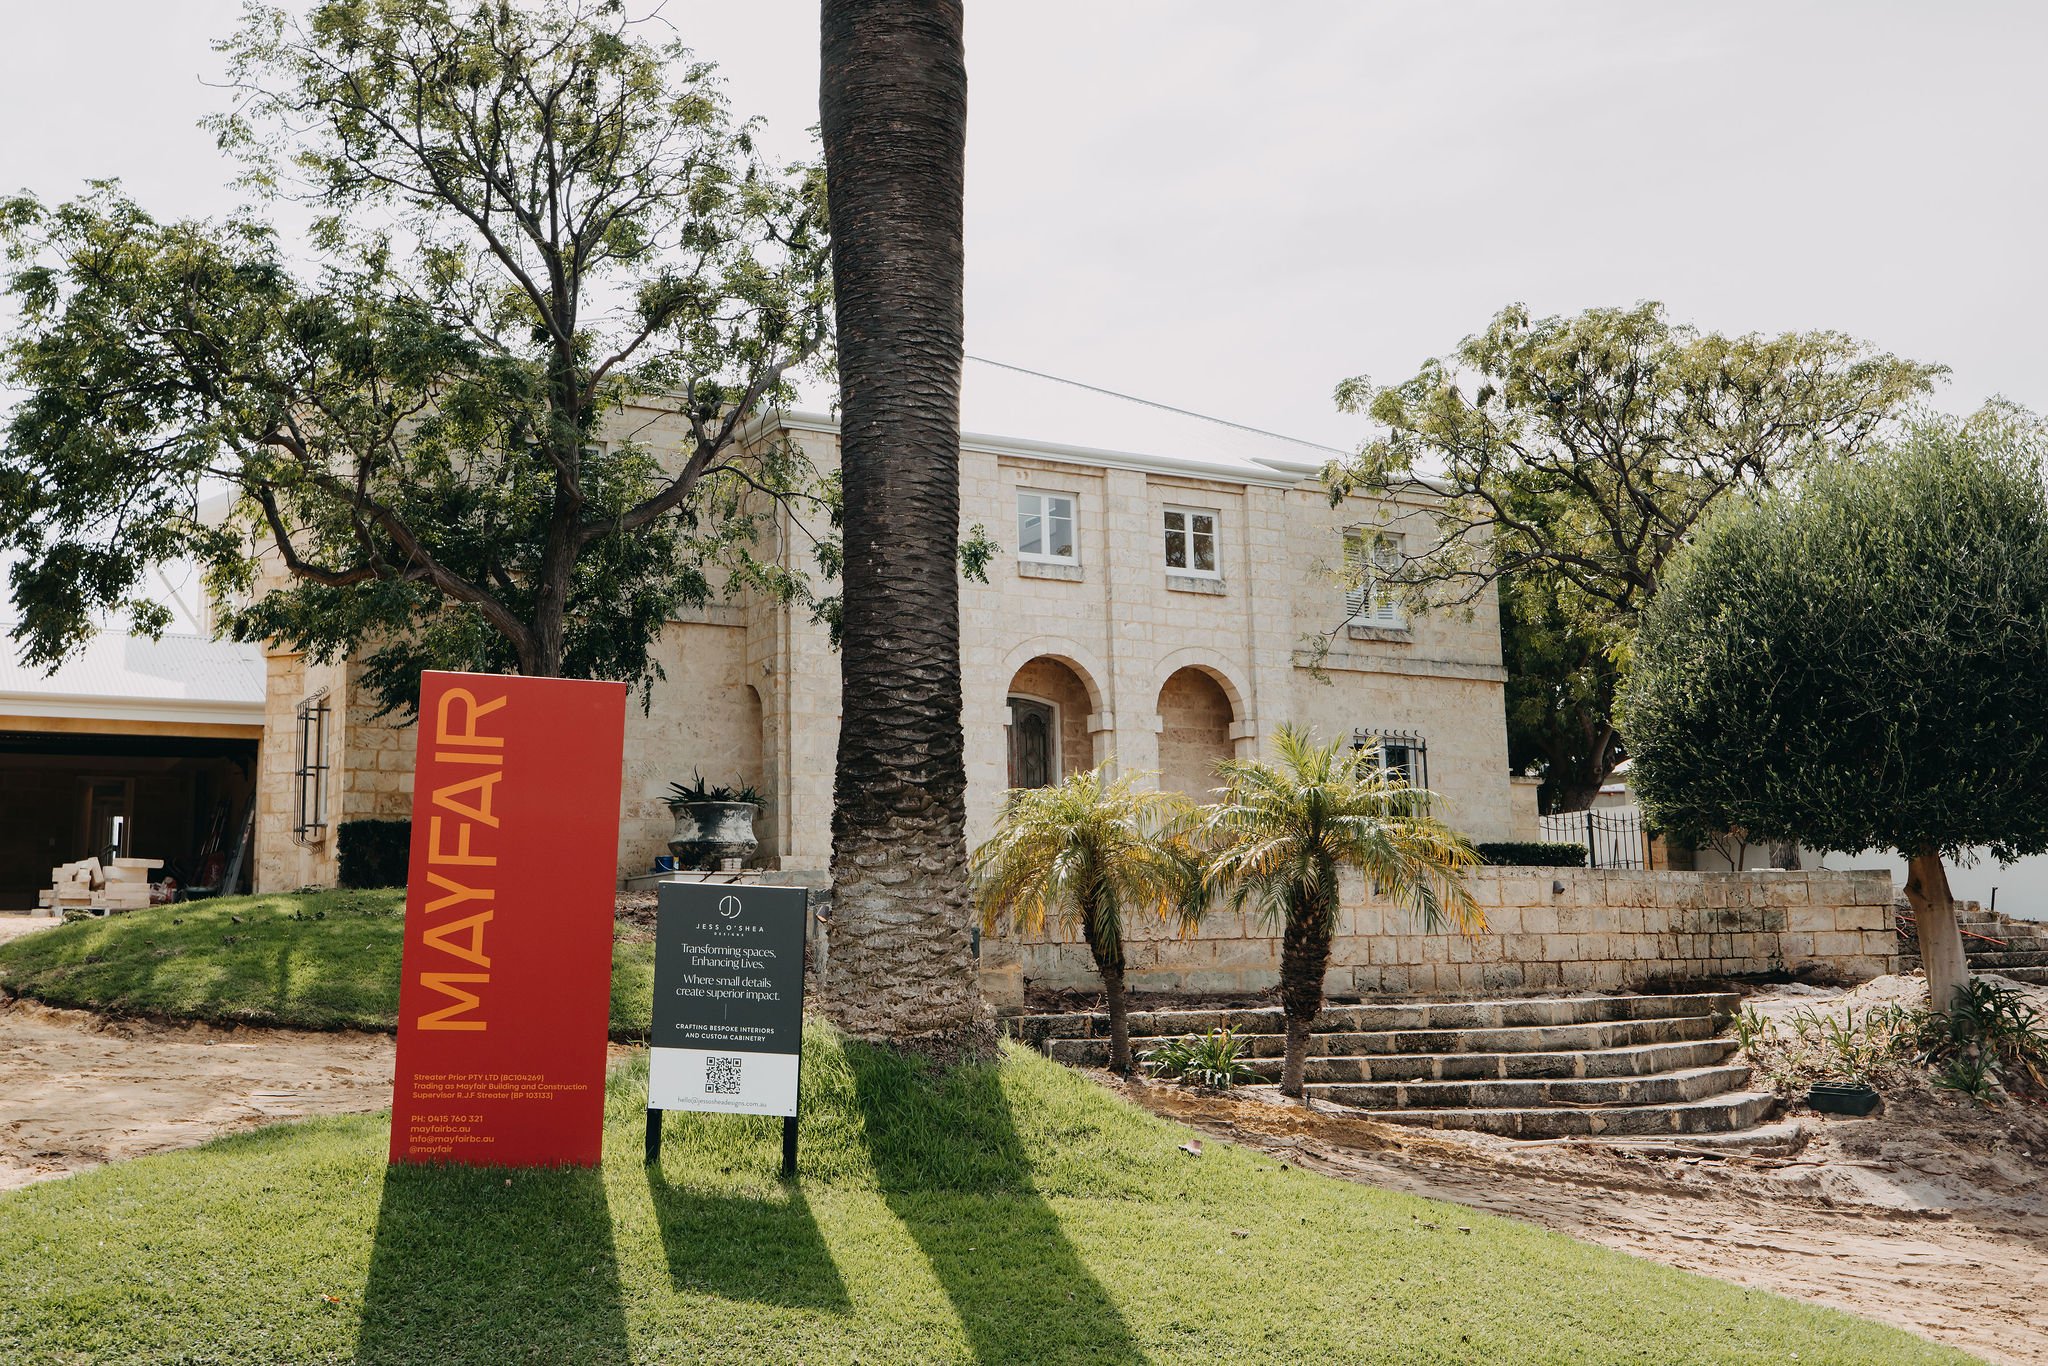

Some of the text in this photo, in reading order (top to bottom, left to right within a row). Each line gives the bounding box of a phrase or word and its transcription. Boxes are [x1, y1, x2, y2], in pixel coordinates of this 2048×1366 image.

[416, 687, 507, 1031] MAYFAIR
[726, 925, 764, 933] O'SHEA
[681, 943, 777, 958] Transforming spaces,
[692, 956, 765, 969] Enhancing Lives.
[683, 974, 771, 988] Where small details
[676, 987, 780, 1002] create superior impact.
[676, 1023, 708, 1031] CRAFTING
[740, 1026, 775, 1034] INTERIORS
[413, 1083, 443, 1091] Trading
[456, 1083, 487, 1091] Mayfair
[488, 1083, 519, 1091] Building
[511, 1092, 524, 1100] (BP
[526, 1092, 553, 1100] 103133)
[678, 1096, 767, 1108] hello@jessosheadesigns.com.au
[411, 1125, 471, 1133] mayfairbc.au
[410, 1135, 494, 1144] info@mayfairbc.au
[409, 1145, 452, 1154] @mayfair
